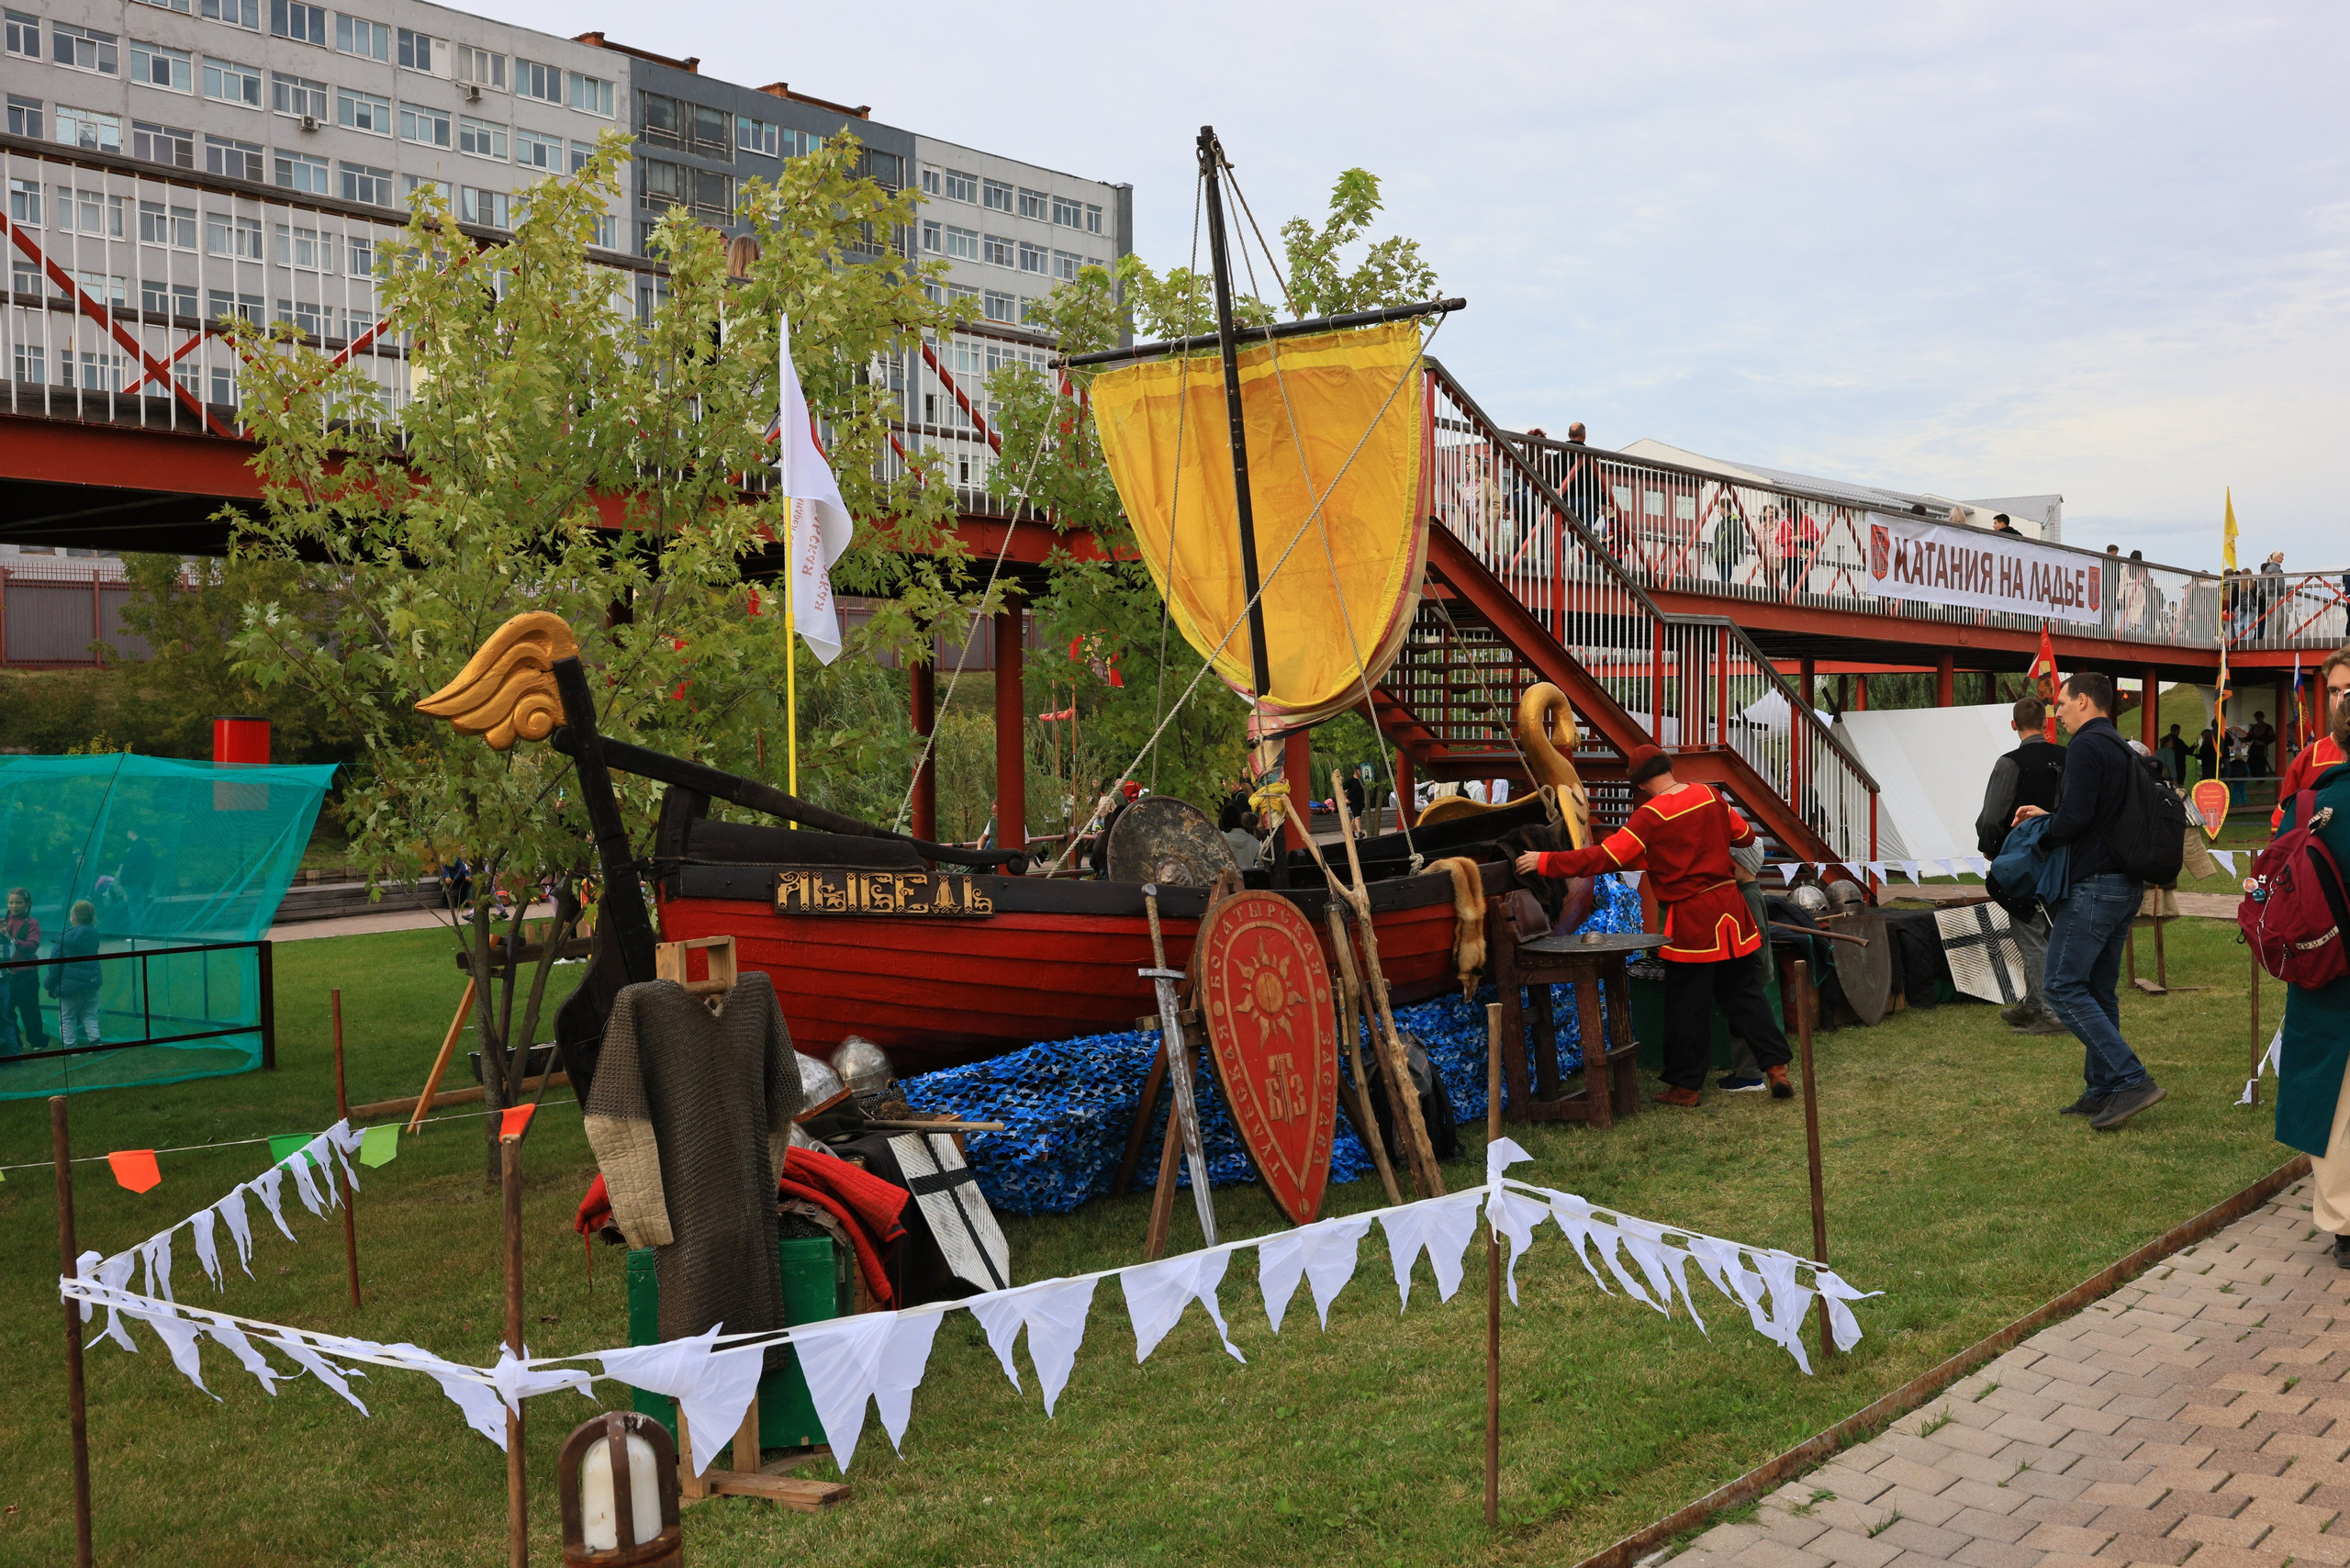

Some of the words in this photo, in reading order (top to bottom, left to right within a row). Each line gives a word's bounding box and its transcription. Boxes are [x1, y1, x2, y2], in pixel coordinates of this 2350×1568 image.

[1894, 537, 1994, 595] КАТАНИЯ
[1999, 554, 2025, 600] НА
[2030, 561, 2085, 613] ЛАДЬЕ
[1210, 902, 1322, 989] БОГАТЫРСКАЯ
[1216, 1025, 1281, 1178] ТУЛЬСКАЯ
[1314, 1030, 1332, 1166] ЗАСТАВА
